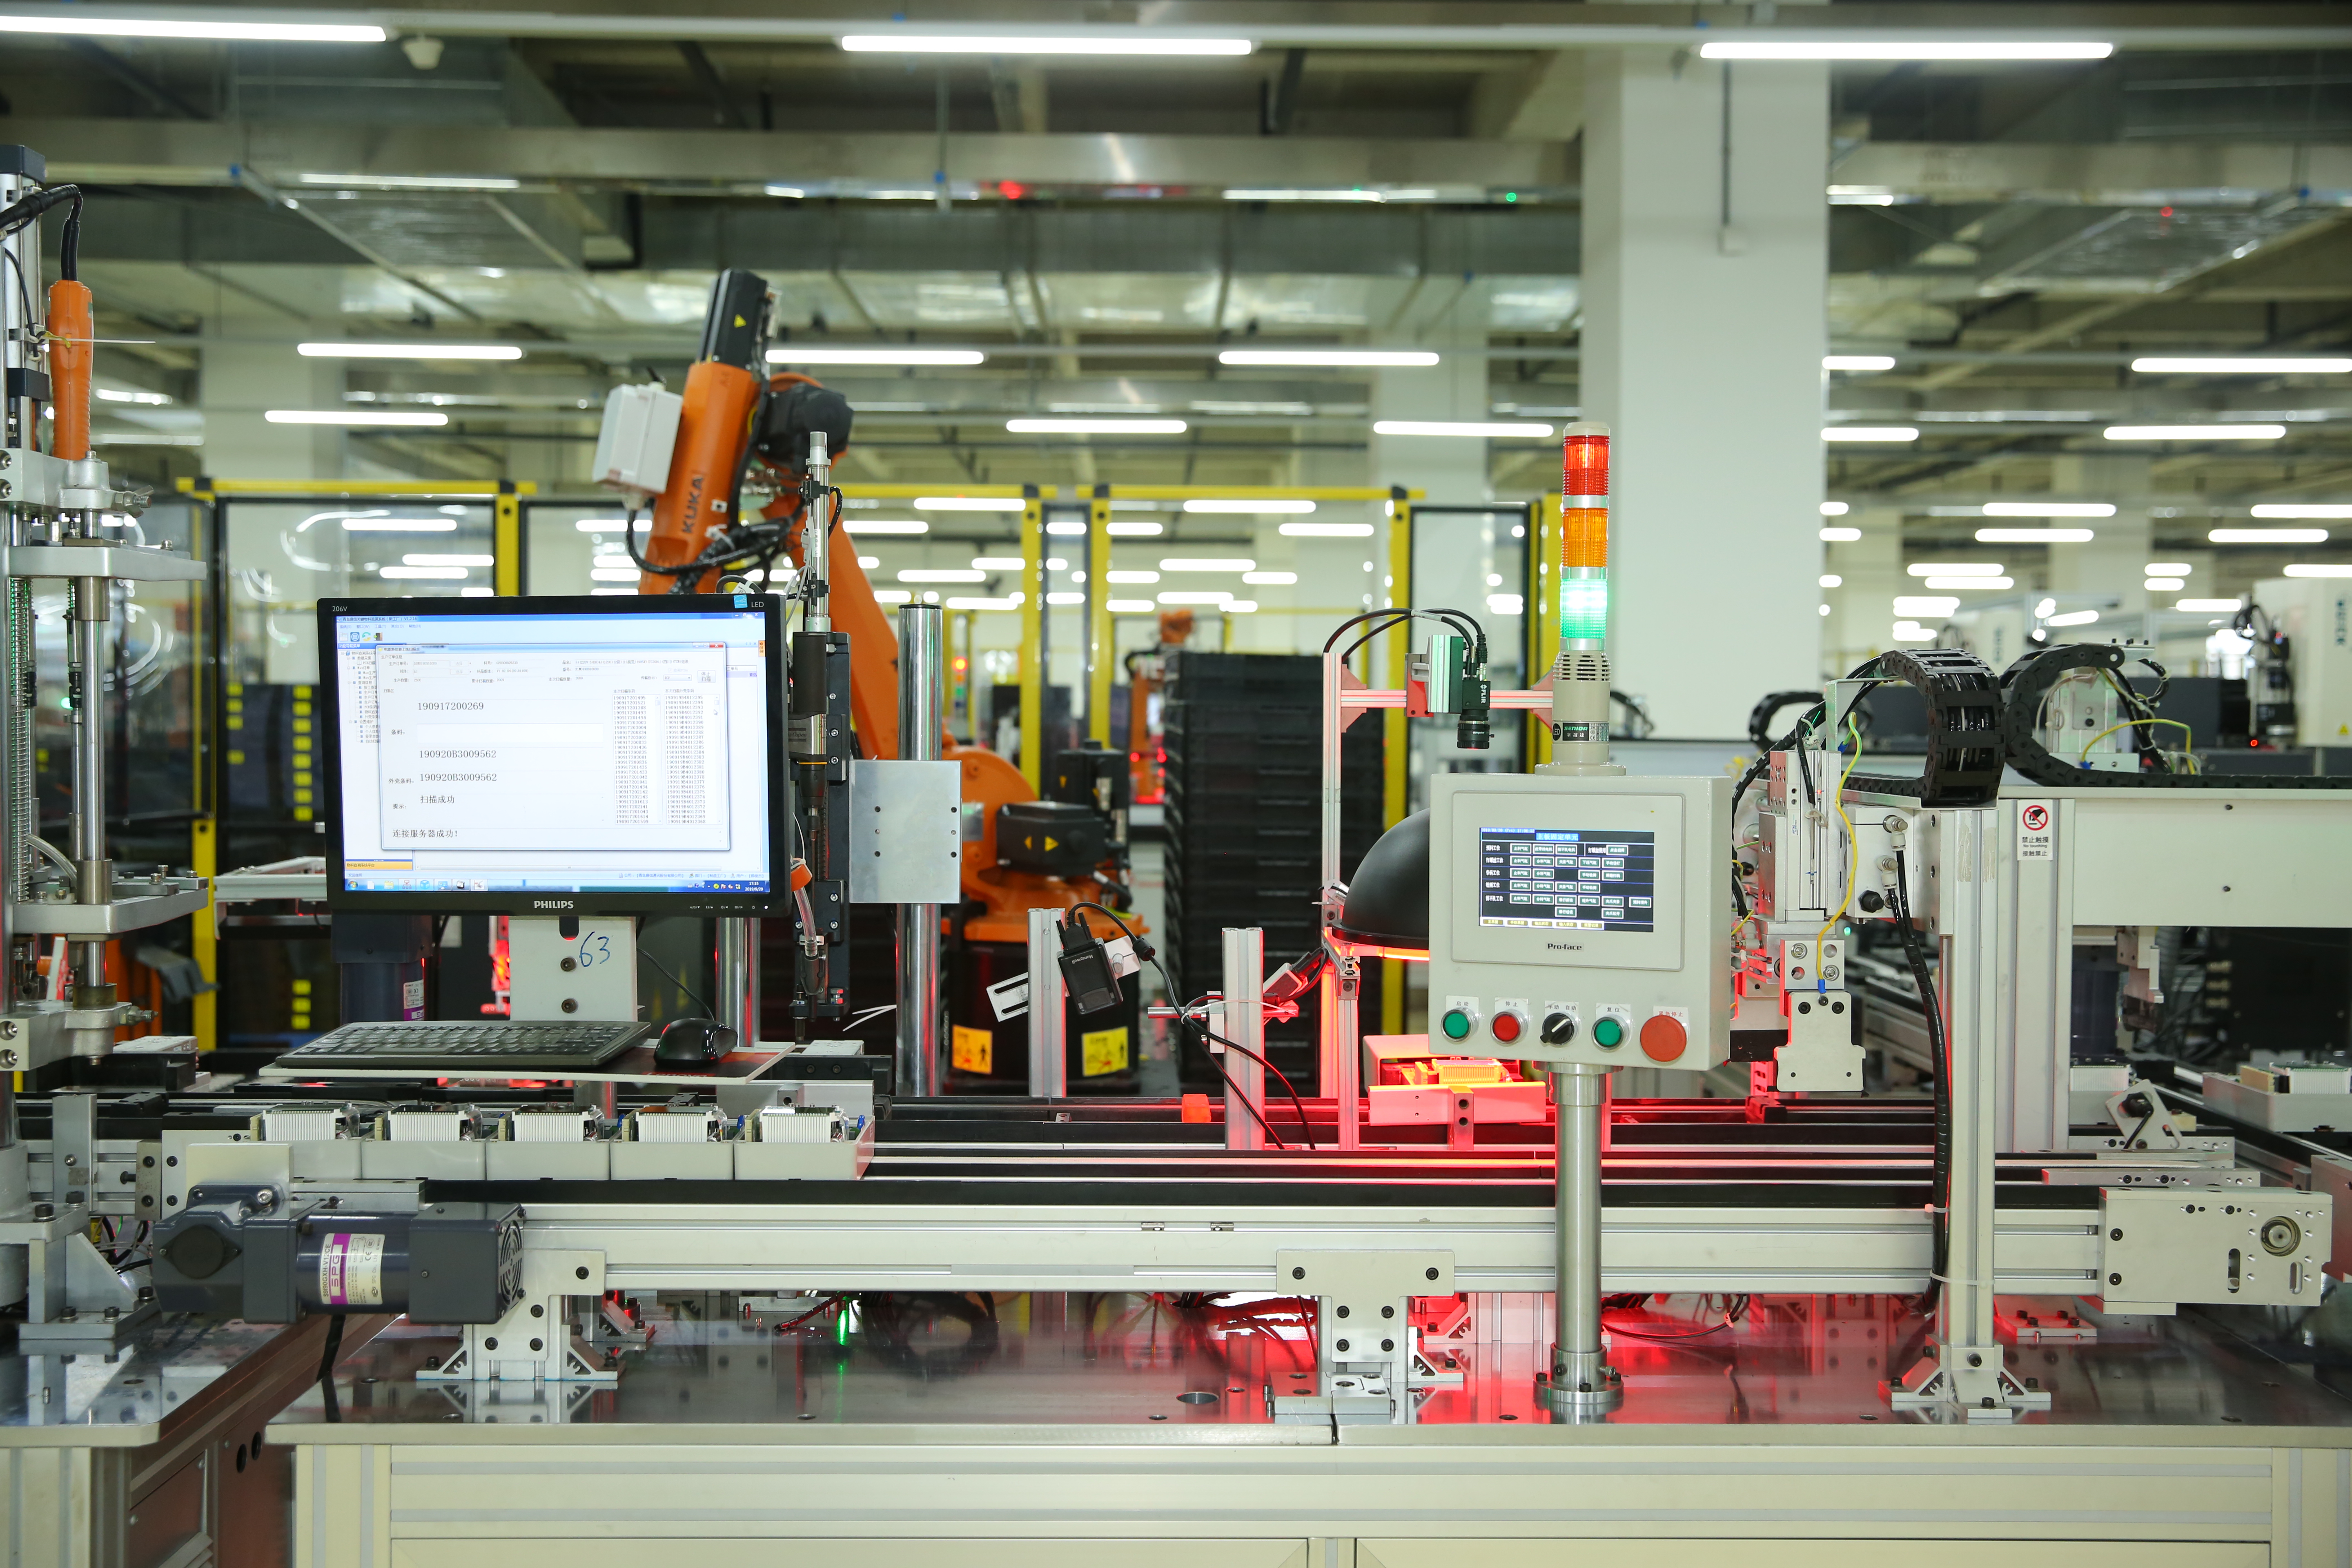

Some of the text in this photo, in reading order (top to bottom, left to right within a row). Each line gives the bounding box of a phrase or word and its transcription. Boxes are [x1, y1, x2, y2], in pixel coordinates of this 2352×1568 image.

[682, 477, 704, 533] KUKA
[420, 773, 497, 782] 190920B3009562
[420, 795, 454, 804] 扫描成功
[534, 901, 574, 909] PHILIPS
[579, 931, 611, 967] 63
[1547, 942, 1582, 951] Pro-face
[1071, 954, 1094, 964] Honeywell
[331, 1255, 340, 1287] SPG
